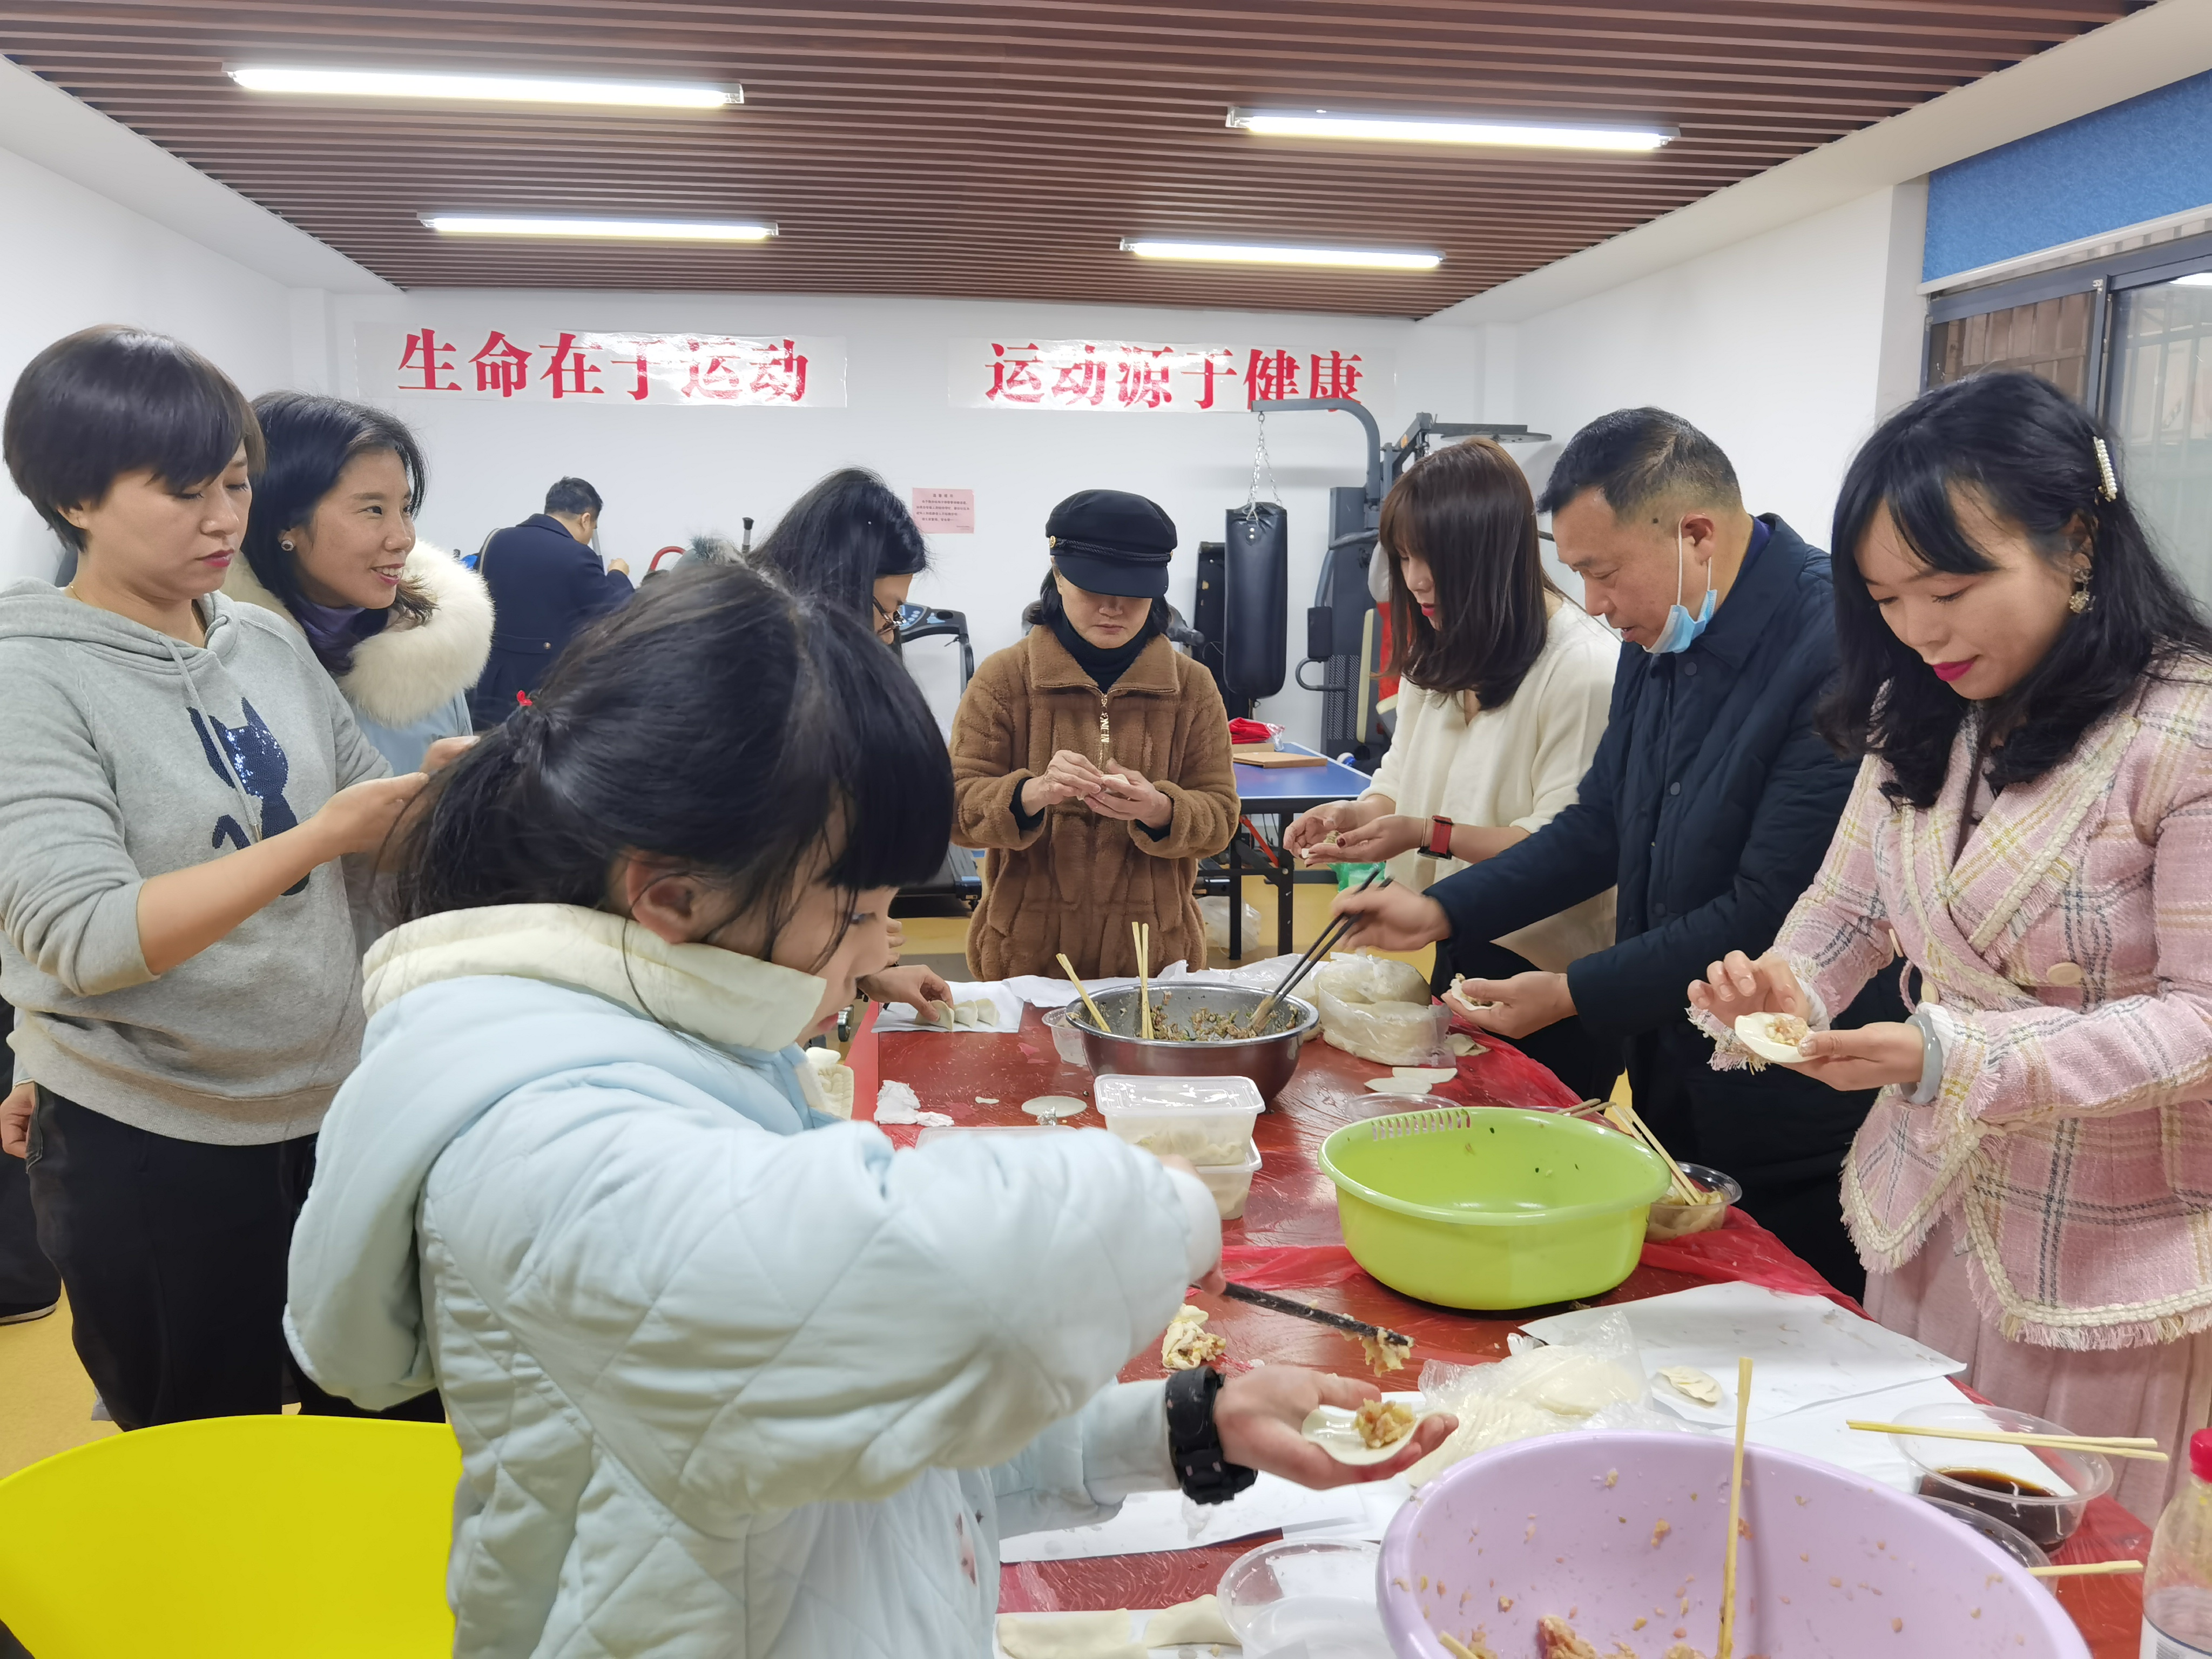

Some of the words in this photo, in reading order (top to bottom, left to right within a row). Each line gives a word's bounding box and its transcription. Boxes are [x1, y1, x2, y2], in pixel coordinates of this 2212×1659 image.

[397, 328, 808, 401] 生命在于运动
[984, 342, 1363, 413] 运动源于健康
